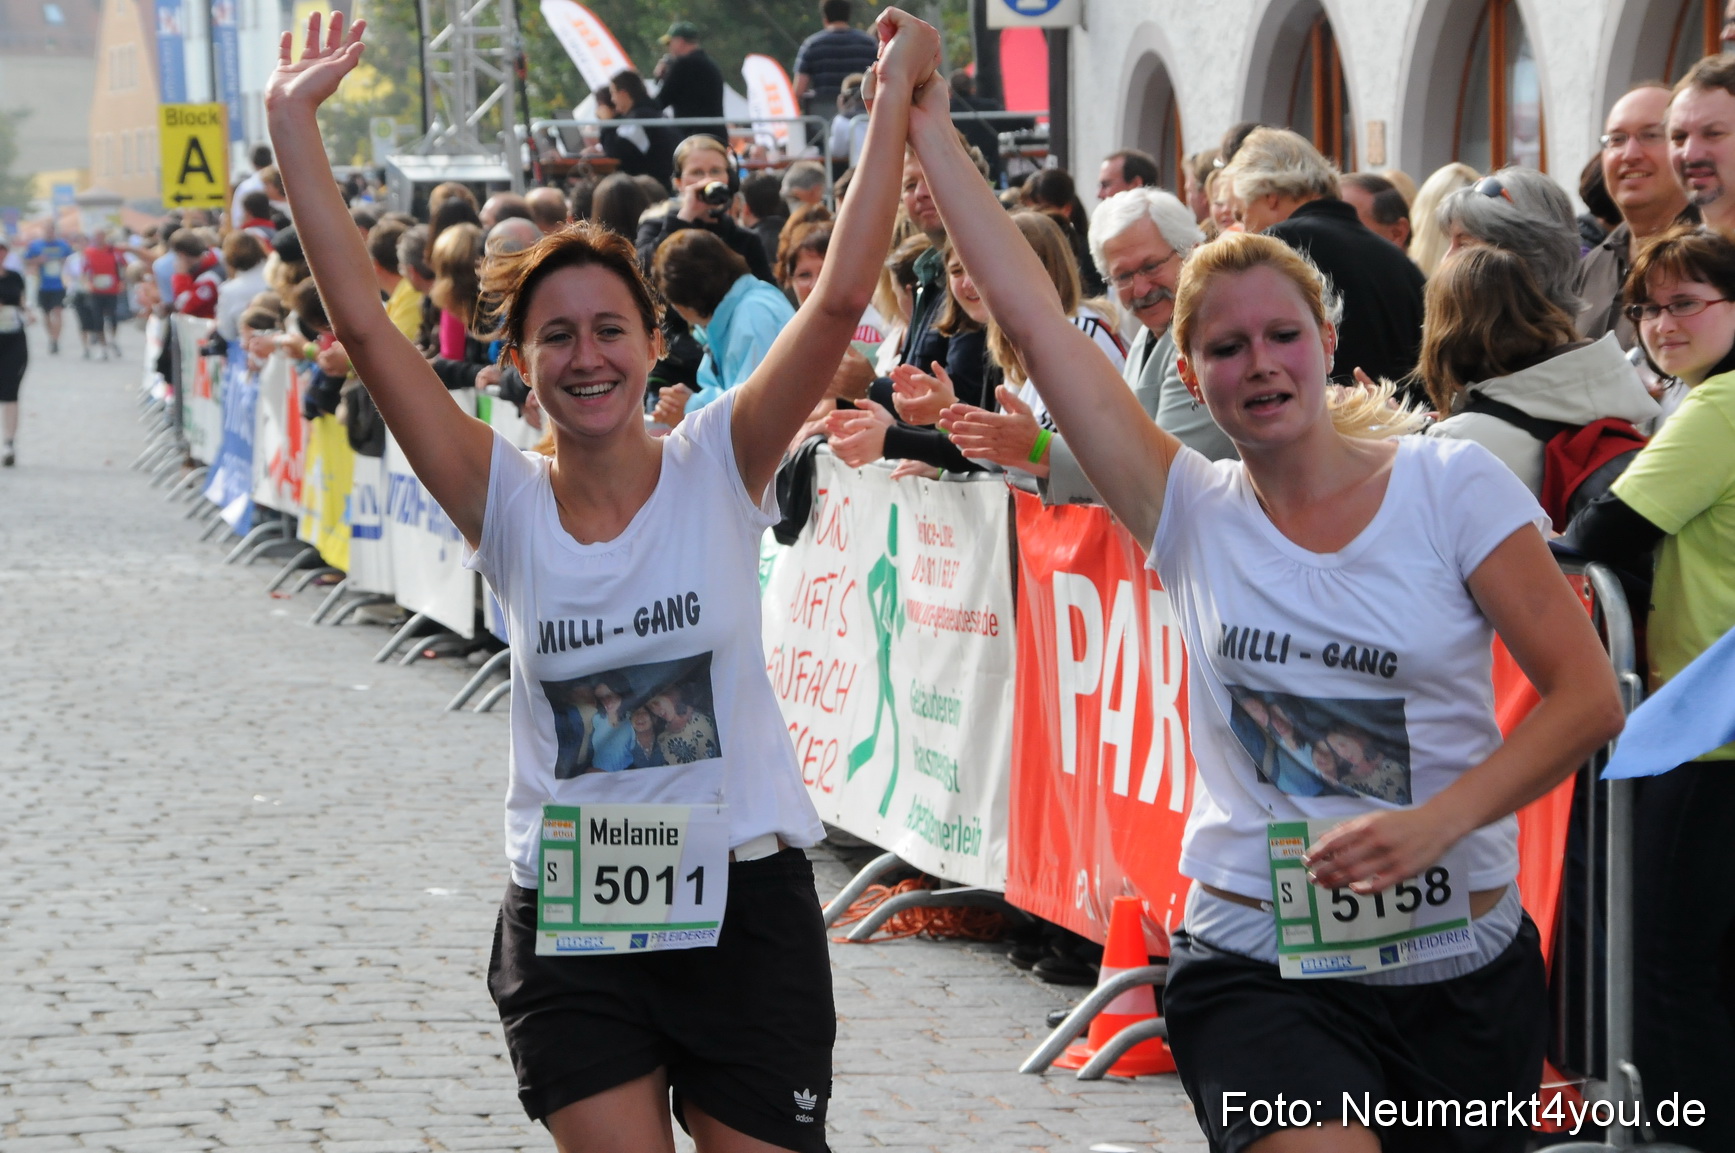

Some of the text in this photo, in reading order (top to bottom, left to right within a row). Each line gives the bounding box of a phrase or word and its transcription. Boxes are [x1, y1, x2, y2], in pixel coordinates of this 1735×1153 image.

[165, 108, 221, 126] Block
[178, 136, 215, 184] A
[537, 591, 701, 654] MILLI - GANG
[1218, 623, 1291, 664] MILLI
[1322, 642, 1398, 679] GANG
[590, 818, 678, 846] Melanie
[547, 862, 557, 882] S
[593, 865, 704, 905] 5011
[1281, 882, 1293, 903] S
[1331, 866, 1452, 922] 5158
[651, 929, 717, 944] PFLEIDERER
[1400, 929, 1471, 955] PFLEIDERER
